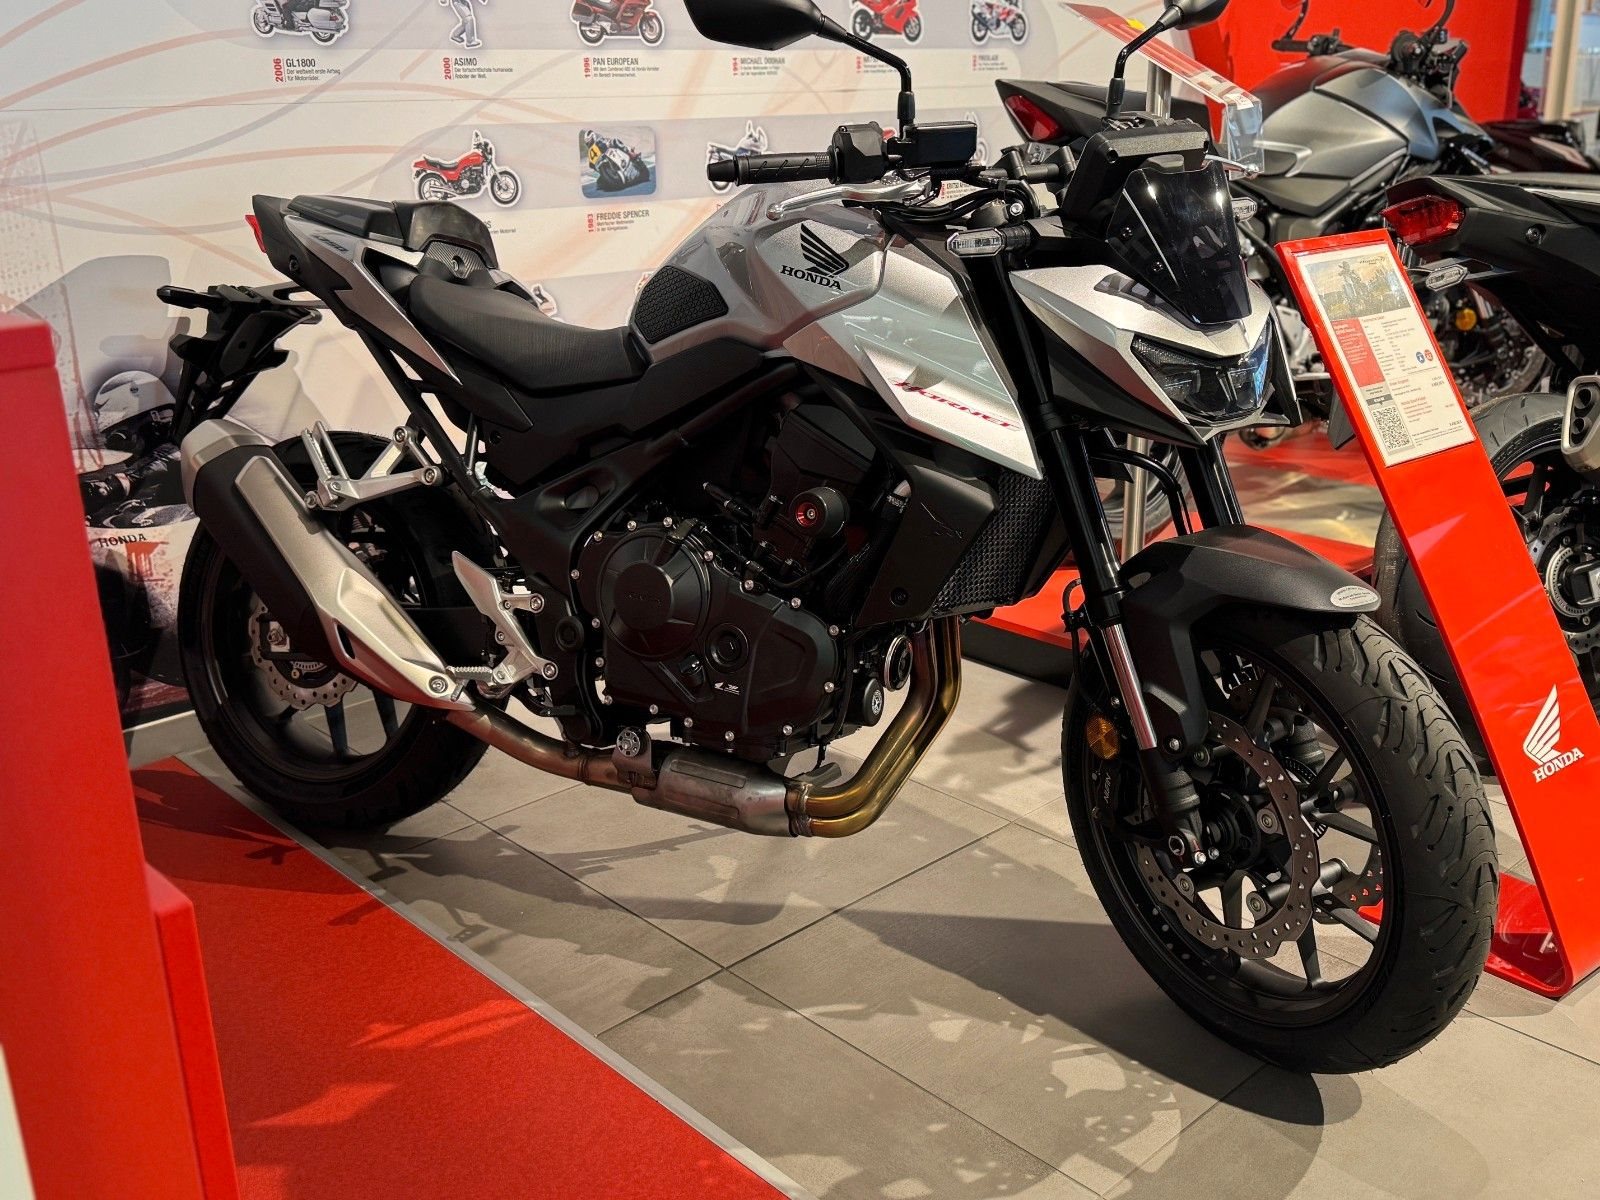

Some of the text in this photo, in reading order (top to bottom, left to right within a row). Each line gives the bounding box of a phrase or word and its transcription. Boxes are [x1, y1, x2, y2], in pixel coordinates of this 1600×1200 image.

[286, 58, 316, 67] GL1800
[454, 57, 477, 66] ASIMO
[593, 57, 639, 65] PAN EUROPEAN
[443, 57, 452, 79] 2000
[596, 209, 650, 221] FREDDIE SPENCER
[780, 264, 843, 291] HONDA
[98, 533, 147, 548] HONDA
[1532, 747, 1585, 783] HONDA
